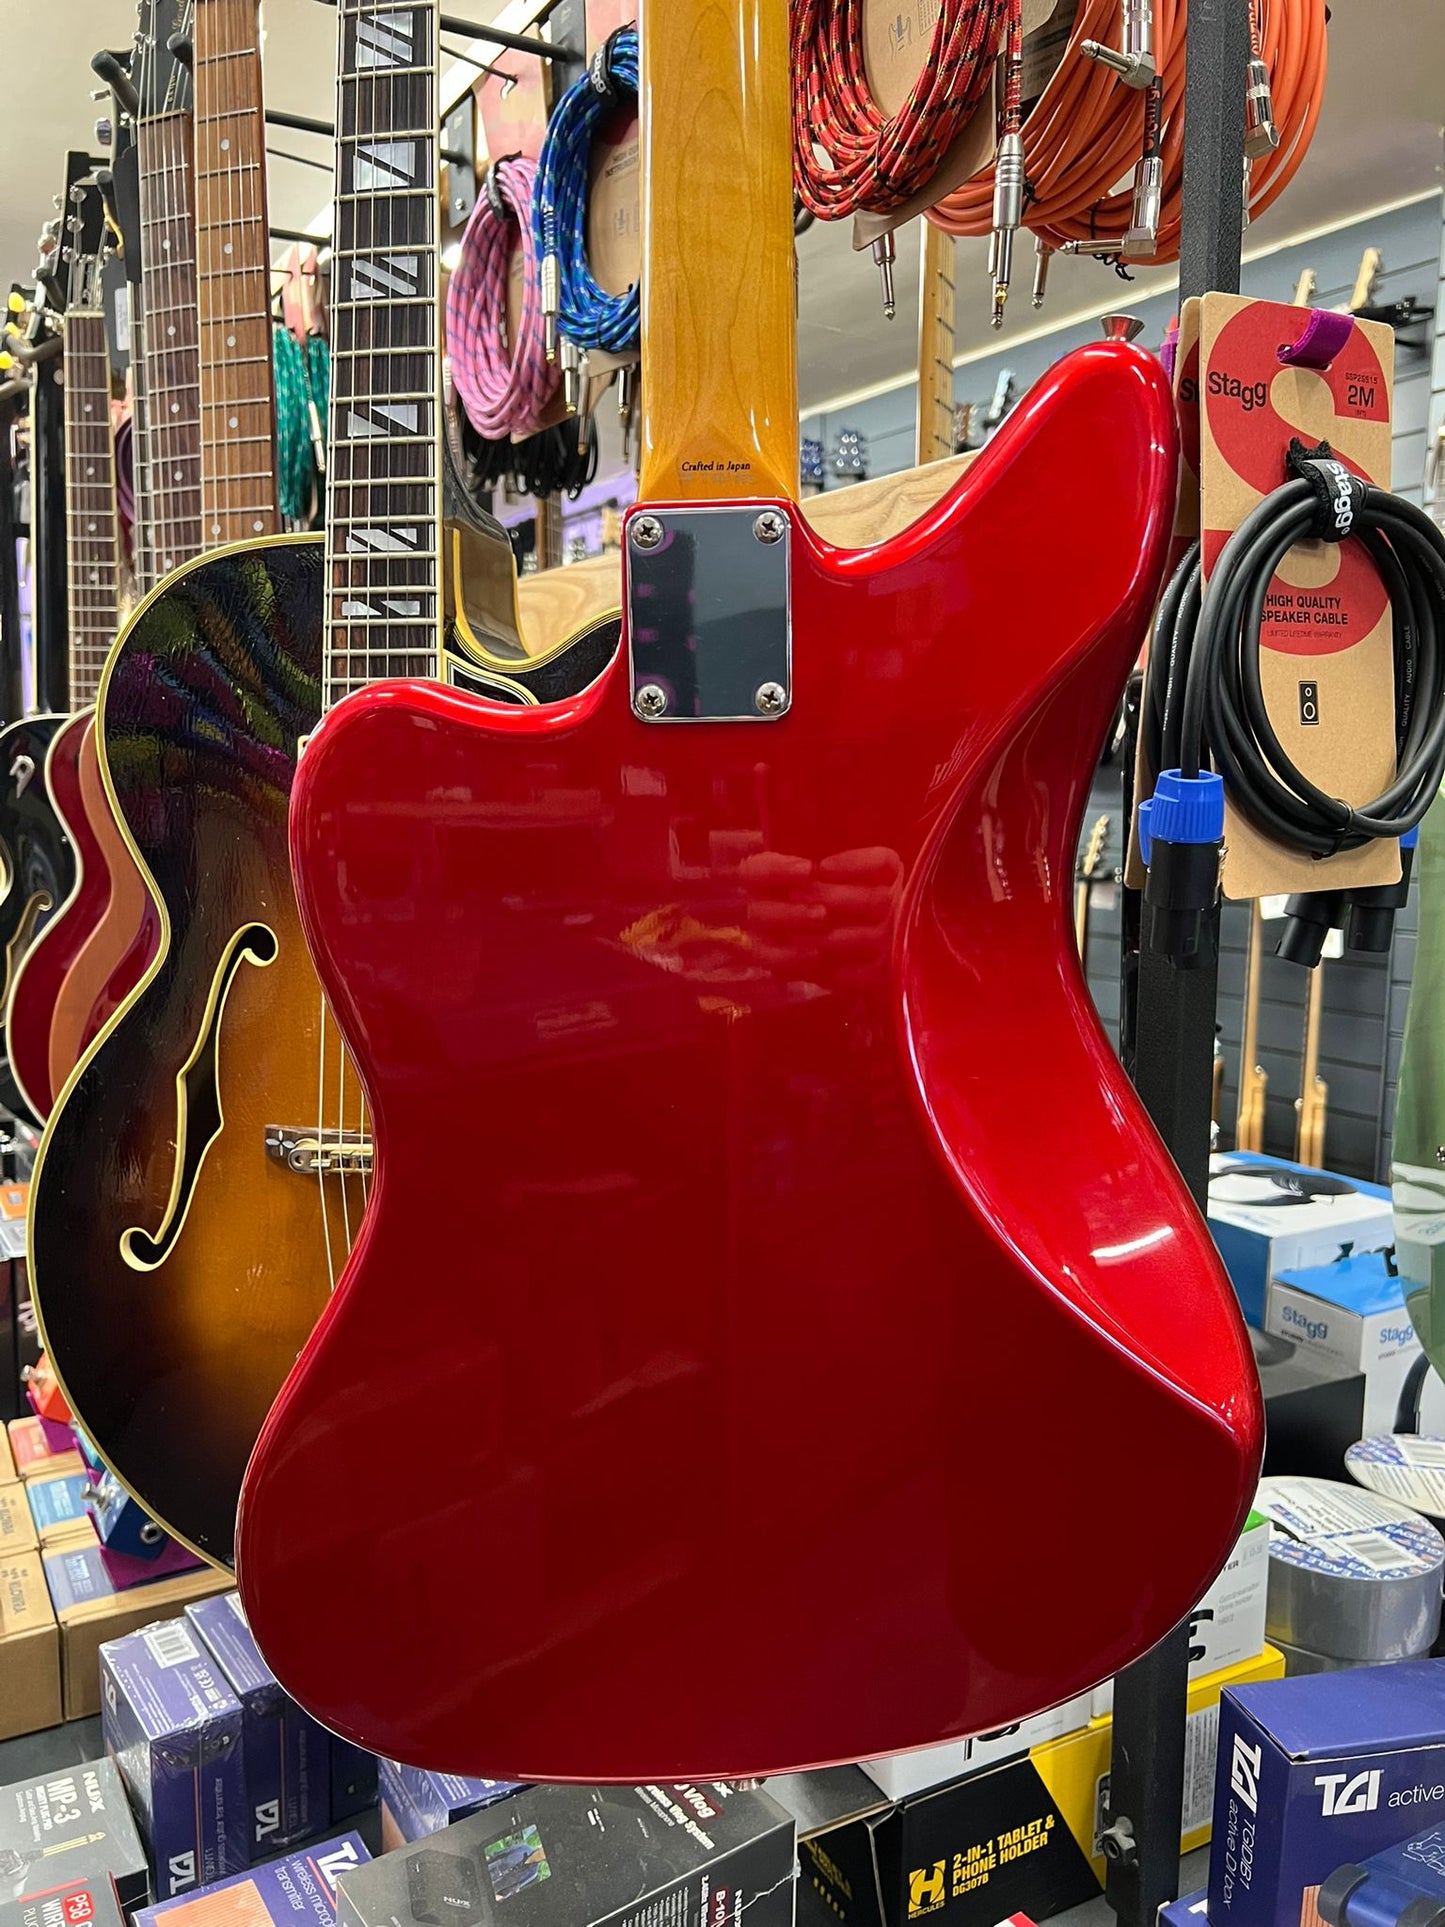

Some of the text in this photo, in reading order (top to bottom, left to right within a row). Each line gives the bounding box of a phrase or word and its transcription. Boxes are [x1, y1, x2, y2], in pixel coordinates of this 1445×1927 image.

[1208, 371, 1267, 411] Stagg
[1348, 384, 1374, 408] 2M
[681, 460, 751, 472] Crafted in Japan
[1326, 462, 1354, 529] stagg
[1260, 610, 1348, 625] SPEAKER CABLE
[1266, 594, 1341, 609] HIGH QUALITY
[1170, 630, 1180, 667] QUALITY
[1177, 592, 1189, 619] AUDIO
[1405, 658, 1413, 684] AUDIO
[1401, 693, 1411, 727] QUALITY
[1282, 1305, 1328, 1339] Stagg
[82, 1771, 106, 1814] NUX
[1231, 1733, 1261, 1814] TGI
[1315, 1769, 1445, 1816] TGI active
[46, 1777, 81, 1825] MP-3
[256, 1799, 279, 1842] TGI
[683, 1787, 716, 1818] Vlog
[684, 1820, 715, 1850] System
[953, 1814, 1055, 1869] 2-IN-1 TABLET &
[1226, 1798, 1239, 1852] active
[169, 1850, 196, 1895] TGI
[292, 1859, 317, 1895] wireless
[317, 1841, 359, 1891] TG
[953, 1831, 1048, 1885] PHONE HOLDER
[66, 1893, 92, 1920] P58
[274, 1866, 306, 1911] transmitter
[1223, 1874, 1235, 1911] box
[908, 1901, 945, 1920] HERCULES
